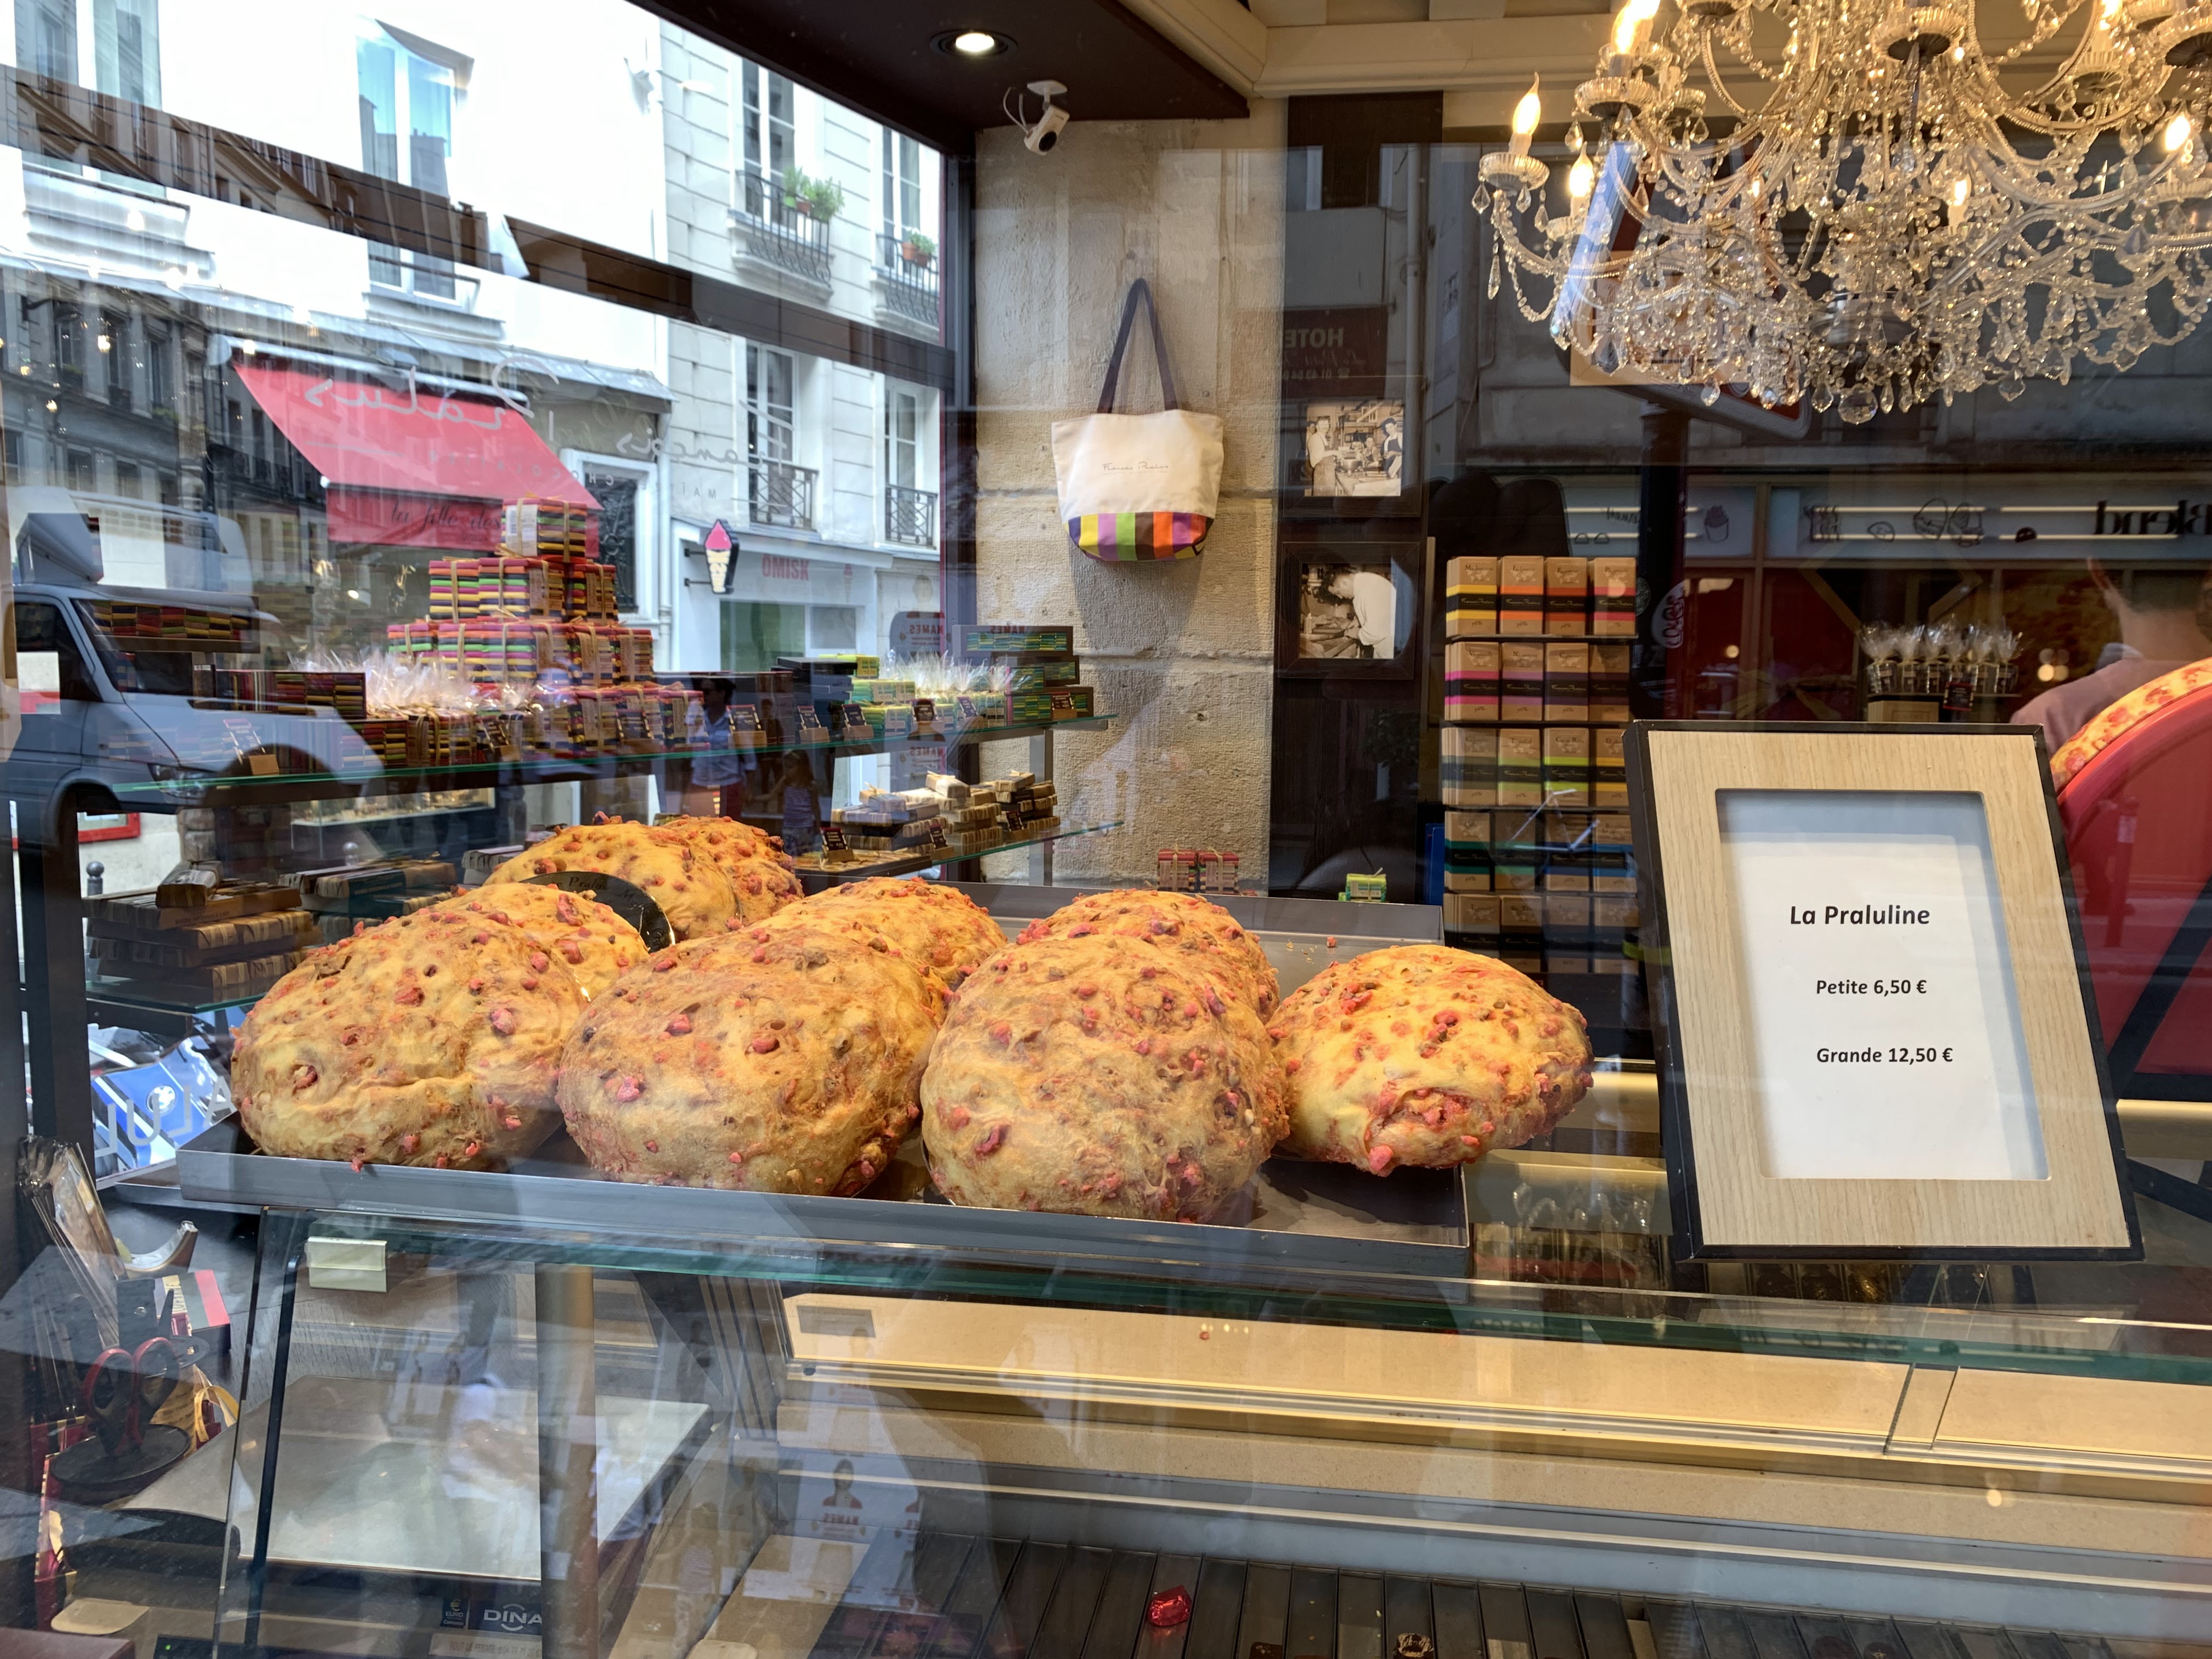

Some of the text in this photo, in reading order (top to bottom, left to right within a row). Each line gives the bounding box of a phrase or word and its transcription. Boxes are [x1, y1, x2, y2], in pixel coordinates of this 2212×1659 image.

[1790, 904, 1931, 924] La Praluline
[1816, 979, 1927, 997] Petite 6,50 €
[1816, 1047, 1954, 1065] Grande 12,50 €
